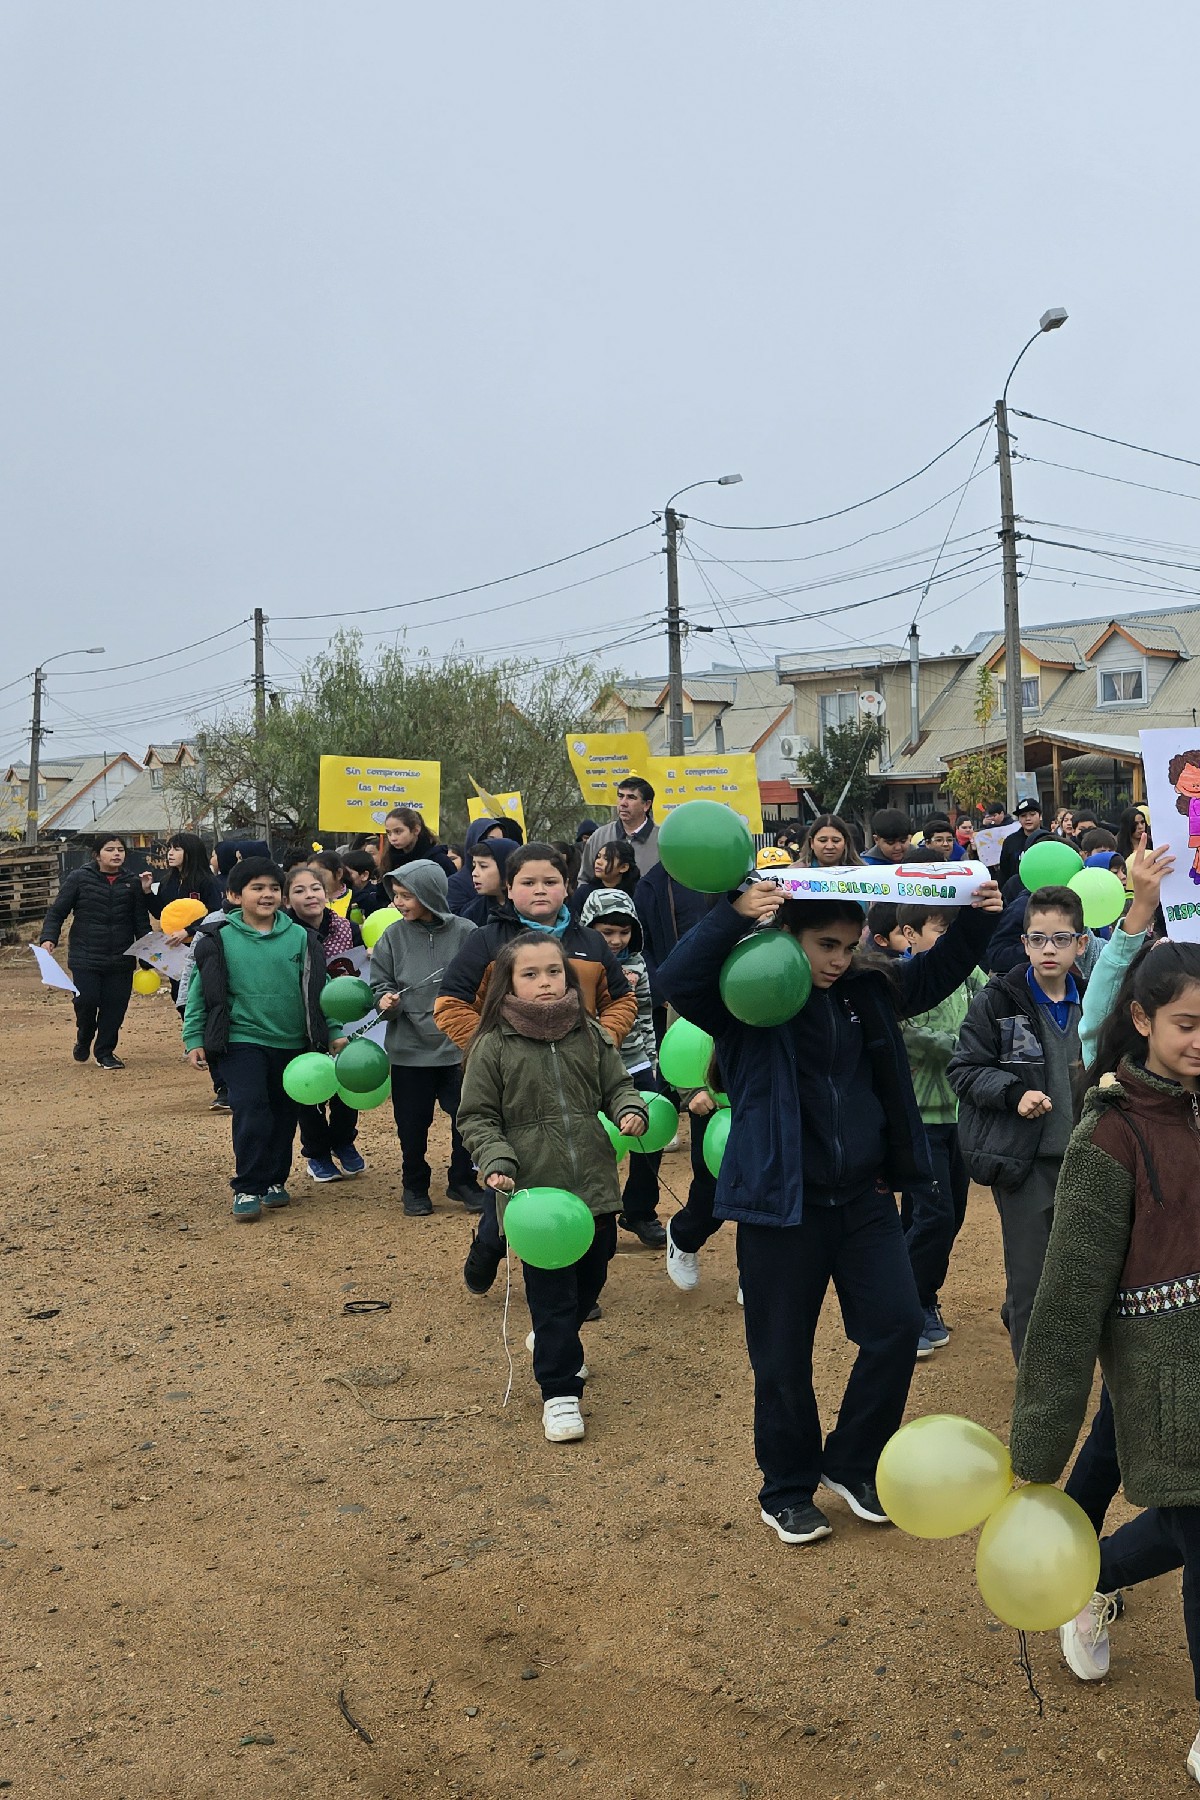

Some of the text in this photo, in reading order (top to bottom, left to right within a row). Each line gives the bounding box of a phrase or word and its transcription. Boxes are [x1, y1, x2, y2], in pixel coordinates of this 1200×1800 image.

[346, 767, 420, 778] Sin compromiso
[684, 767, 728, 776] compromiso
[358, 783, 405, 792] las metas
[665, 786, 674, 794] en
[369, 799, 389, 807] solo
[776, 879, 957, 898] SPONSABILIDAD ESCOLAR
